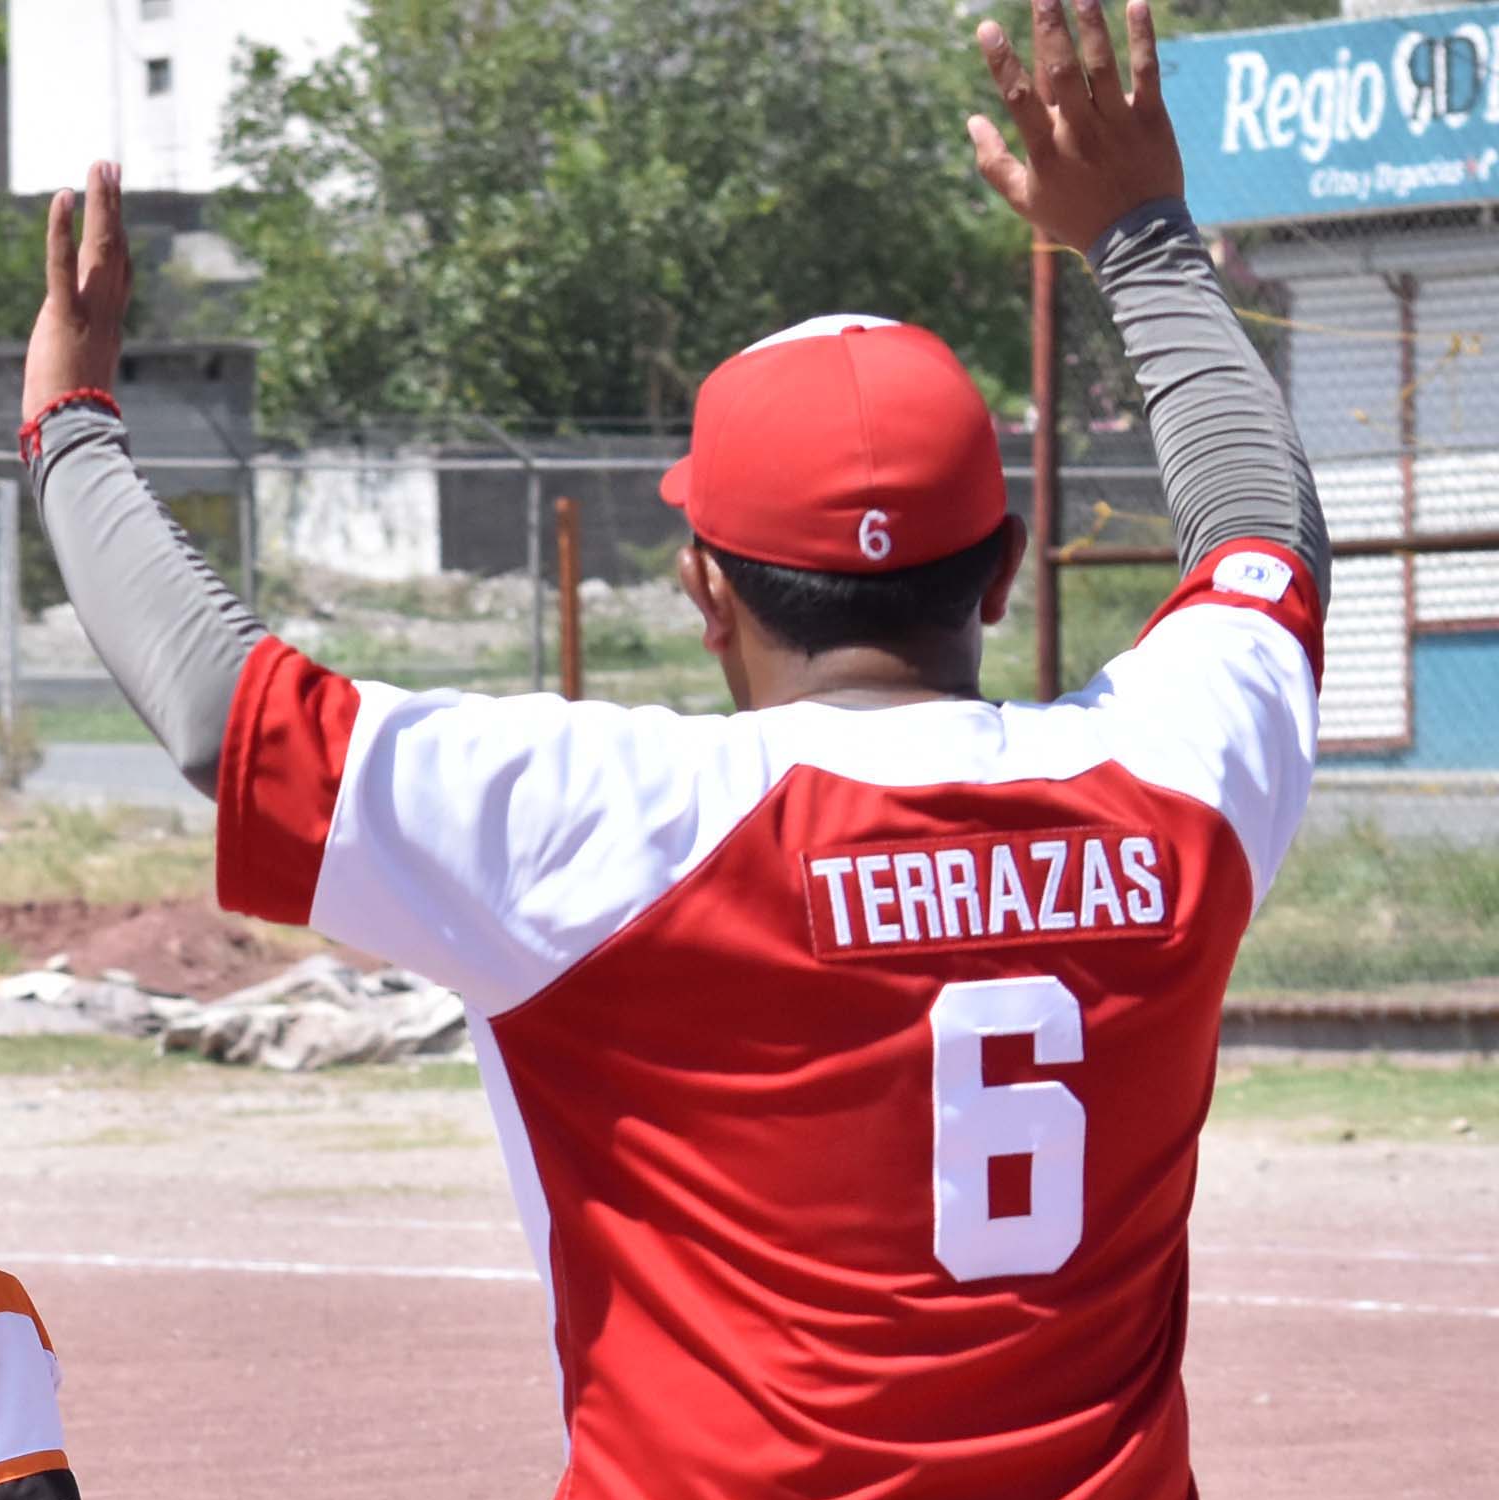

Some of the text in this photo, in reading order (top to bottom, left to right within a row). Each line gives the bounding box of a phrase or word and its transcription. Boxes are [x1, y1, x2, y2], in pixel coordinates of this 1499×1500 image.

[1221, 48, 1386, 163] Regio
[858, 509, 892, 561] 6
[810, 836, 1166, 947] TERRAZAS
[931, 975, 1086, 1283] 6
